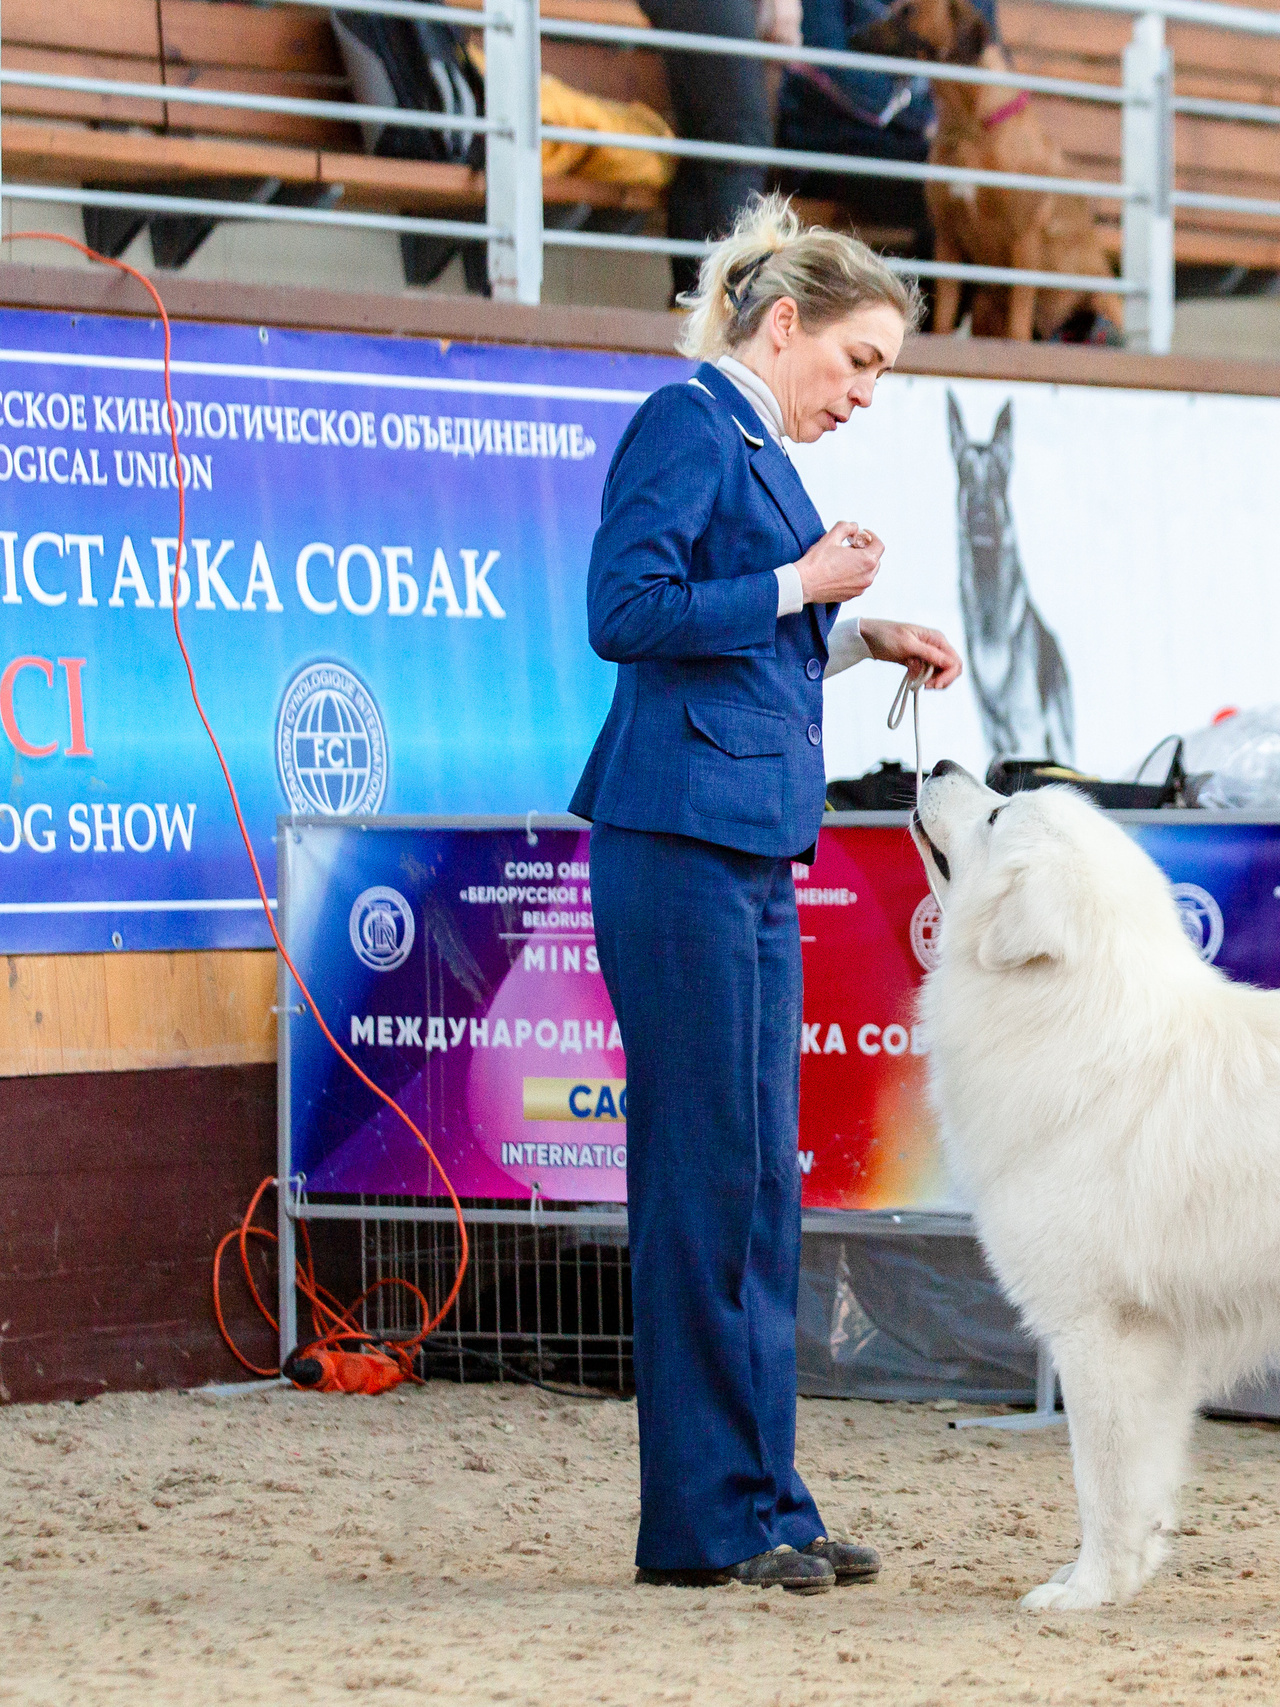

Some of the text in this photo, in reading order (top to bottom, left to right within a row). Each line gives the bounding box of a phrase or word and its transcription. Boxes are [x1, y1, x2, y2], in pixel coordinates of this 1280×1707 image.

[0, 390, 597, 461] СКОЕ КИНОЛОГИЧЕСКОЕ ОБЪЕДИНЕНИЕ»
[113, 449, 213, 491] UNION
[295, 543, 506, 619] СОБАК
[313, 737, 353, 769] FCI
[68, 803, 198, 853] SHOW
[504, 861, 554, 880] СОЮЗ
